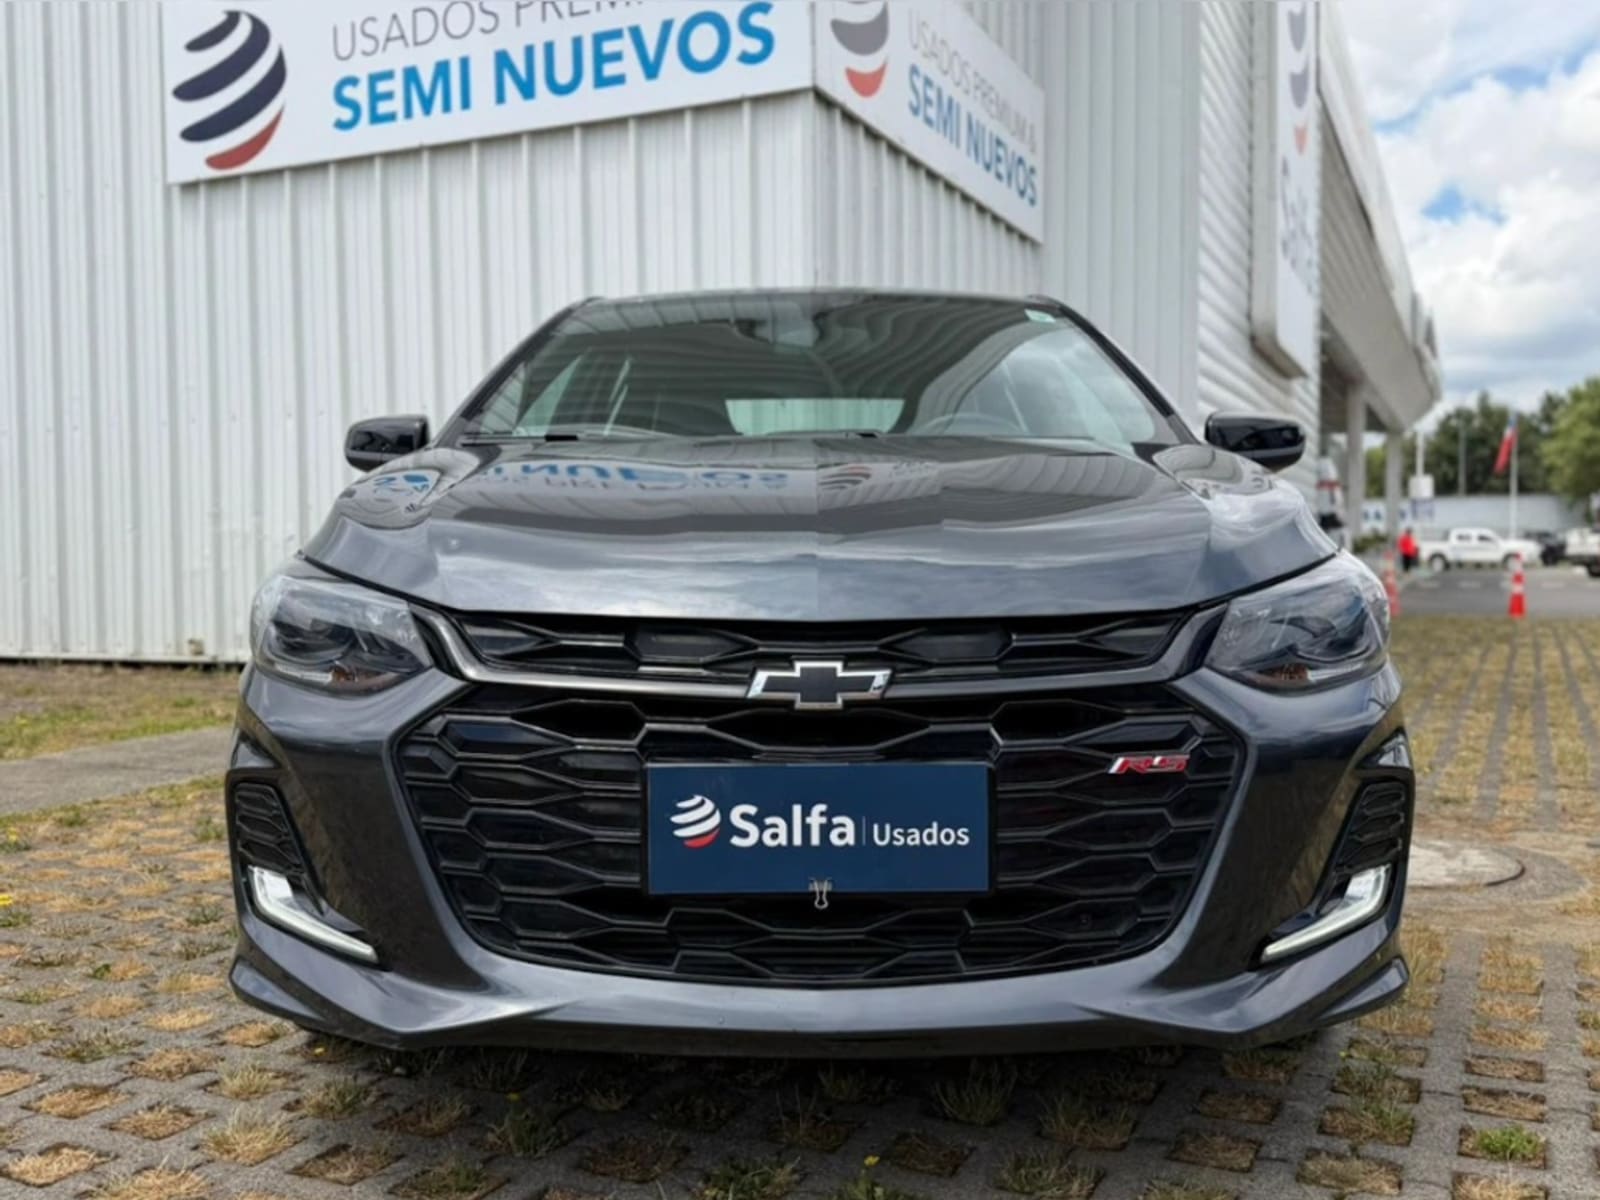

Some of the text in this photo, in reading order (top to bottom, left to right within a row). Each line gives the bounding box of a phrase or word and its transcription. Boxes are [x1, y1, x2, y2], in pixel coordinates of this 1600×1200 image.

[332, 1, 500, 61] USADOS
[333, 1, 775, 132] SEMI NUEVOS
[907, 8, 971, 96] USADOS
[908, 63, 1037, 208] SEMI NUEVOS
[1107, 754, 1190, 774] RS
[729, 803, 970, 848] Salfa Usados
